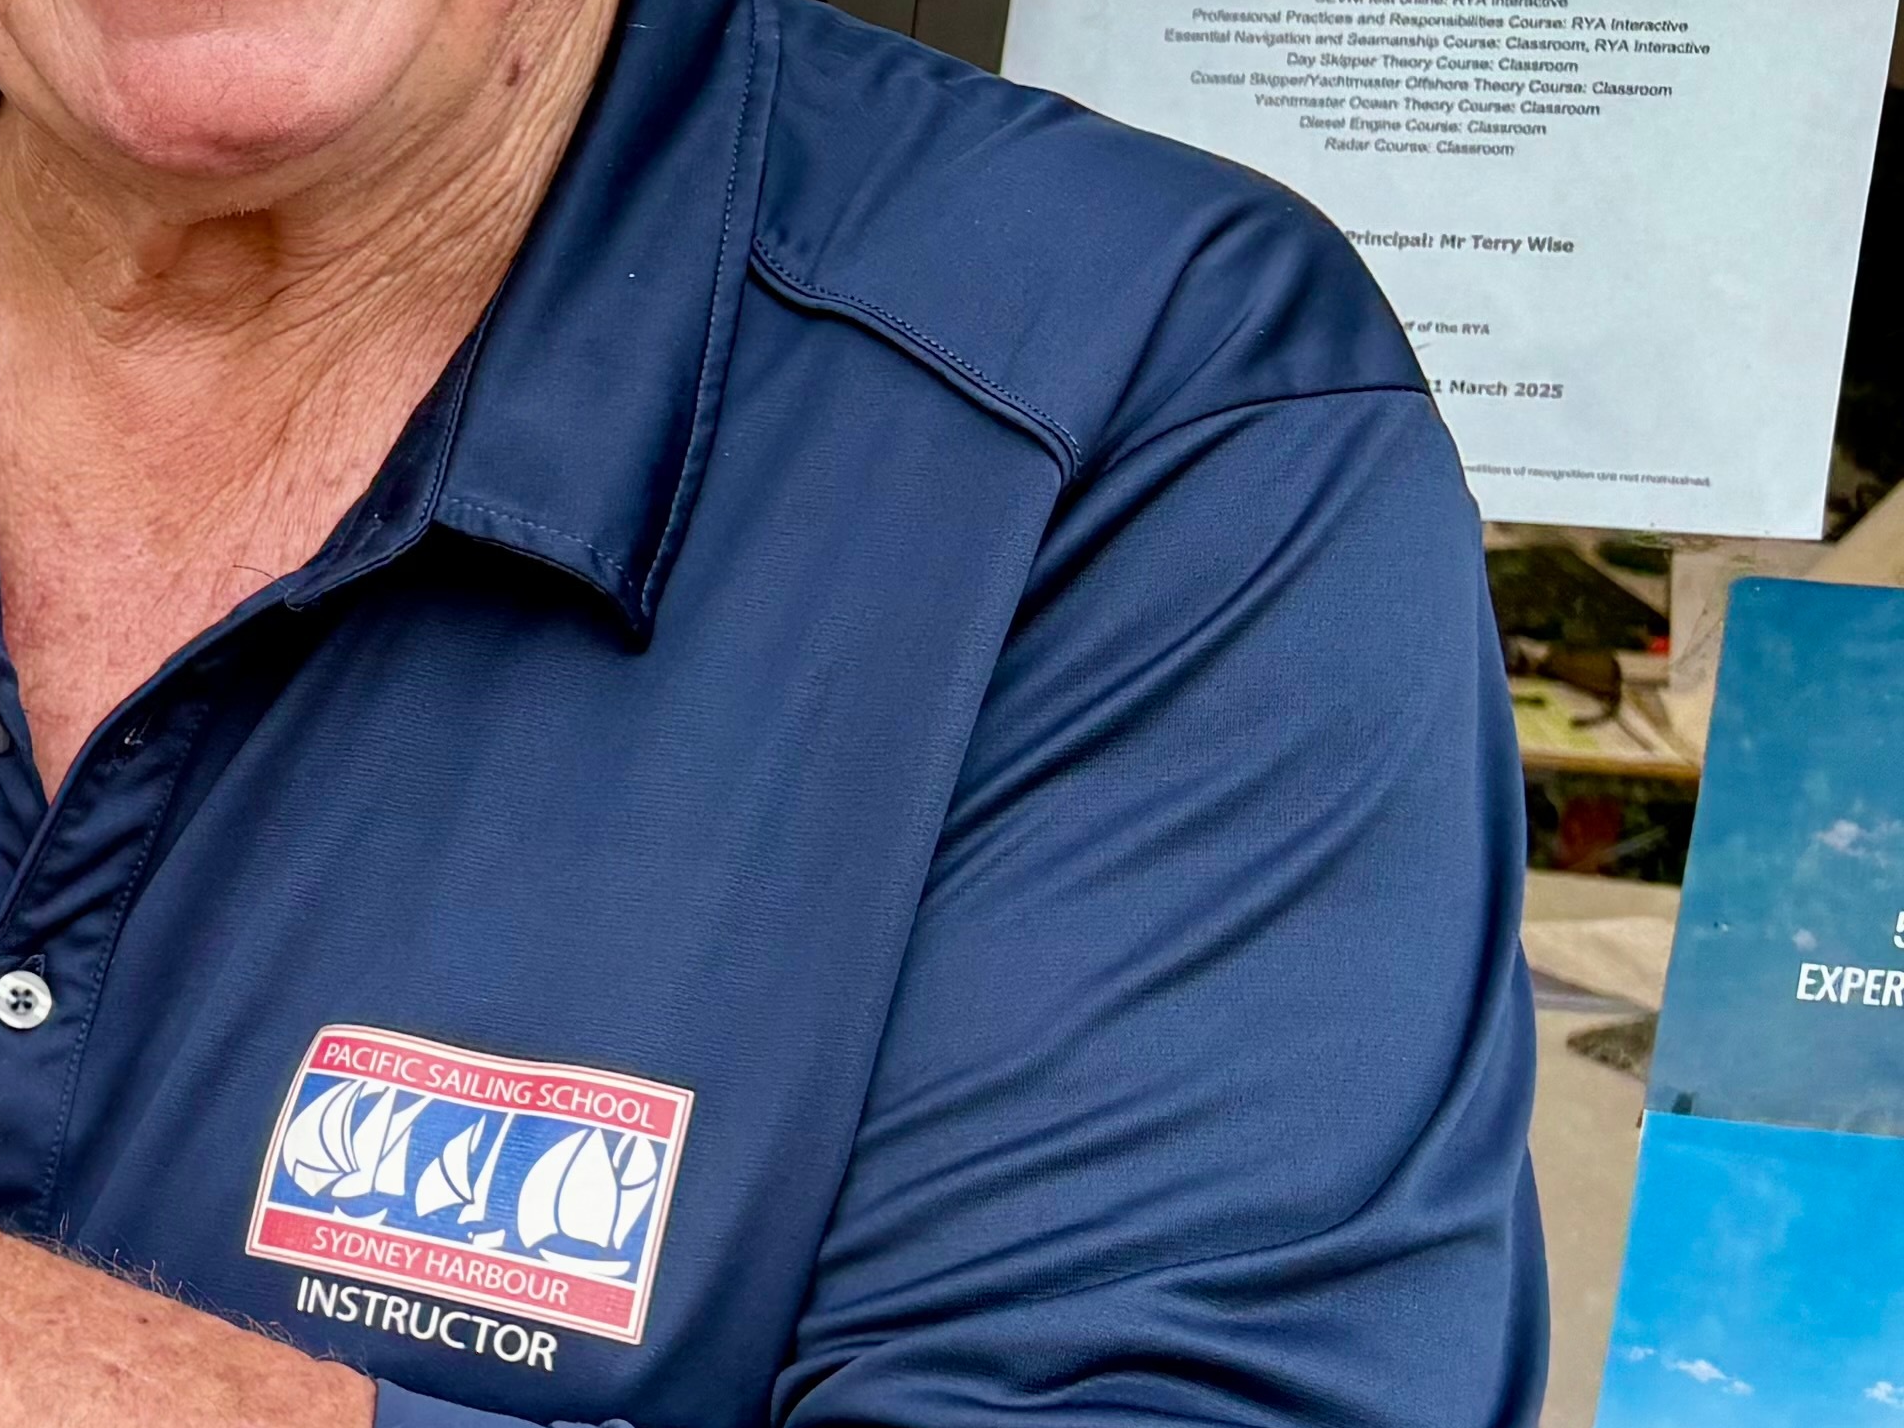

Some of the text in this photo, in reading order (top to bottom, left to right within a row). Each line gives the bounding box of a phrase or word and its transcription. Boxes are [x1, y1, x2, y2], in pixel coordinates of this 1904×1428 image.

[1191, 7, 1283, 23] Professional
[1285, 9, 1354, 24] Practices
[1357, 11, 1386, 25] and
[1389, 11, 1504, 31] Responsibilities
[1570, 16, 1607, 32] RYA
[1610, 17, 1689, 34] Interactive
[1163, 27, 1231, 44] Essential
[1233, 29, 1312, 49] Navigation
[1314, 31, 1343, 46] and
[1346, 32, 1440, 51] Seamanship
[1593, 38, 1630, 54] RYA
[1633, 39, 1711, 56] Interactive
[1286, 51, 1317, 69] Day
[1319, 52, 1378, 69] Skipper
[1382, 54, 1434, 72] Theory
[1498, 57, 1579, 73] Classroom
[1190, 70, 1246, 86] Coastal
[1404, 76, 1469, 91] Offshore
[1473, 77, 1526, 95] Theory
[1592, 80, 1673, 97] Classroom
[1254, 93, 1346, 109] Yachtmaster
[1348, 95, 1399, 111] Ocean
[1402, 97, 1454, 115] Theory
[1520, 99, 1601, 116] Classroom
[1299, 115, 1346, 130] Diesel
[1348, 116, 1401, 134] Engine
[1466, 120, 1547, 136] Classroom
[1324, 136, 1371, 152] Radar
[1436, 139, 1516, 156] Classroom
[1439, 233, 1467, 250] Mr
[1471, 234, 1523, 255] Terry
[1526, 235, 1575, 254] Wise
[1435, 322, 1458, 335] the
[1461, 323, 1491, 336] RYA
[1448, 379, 1508, 398] March
[1513, 382, 1565, 400] 2025
[1796, 962, 1904, 1007] EXPER
[323, 1043, 656, 1130] PACIFIC SAILING SCHOOL
[312, 1226, 569, 1305] SYDNEY HARBOUR
[297, 1276, 558, 1371] INSTRUCTOR
